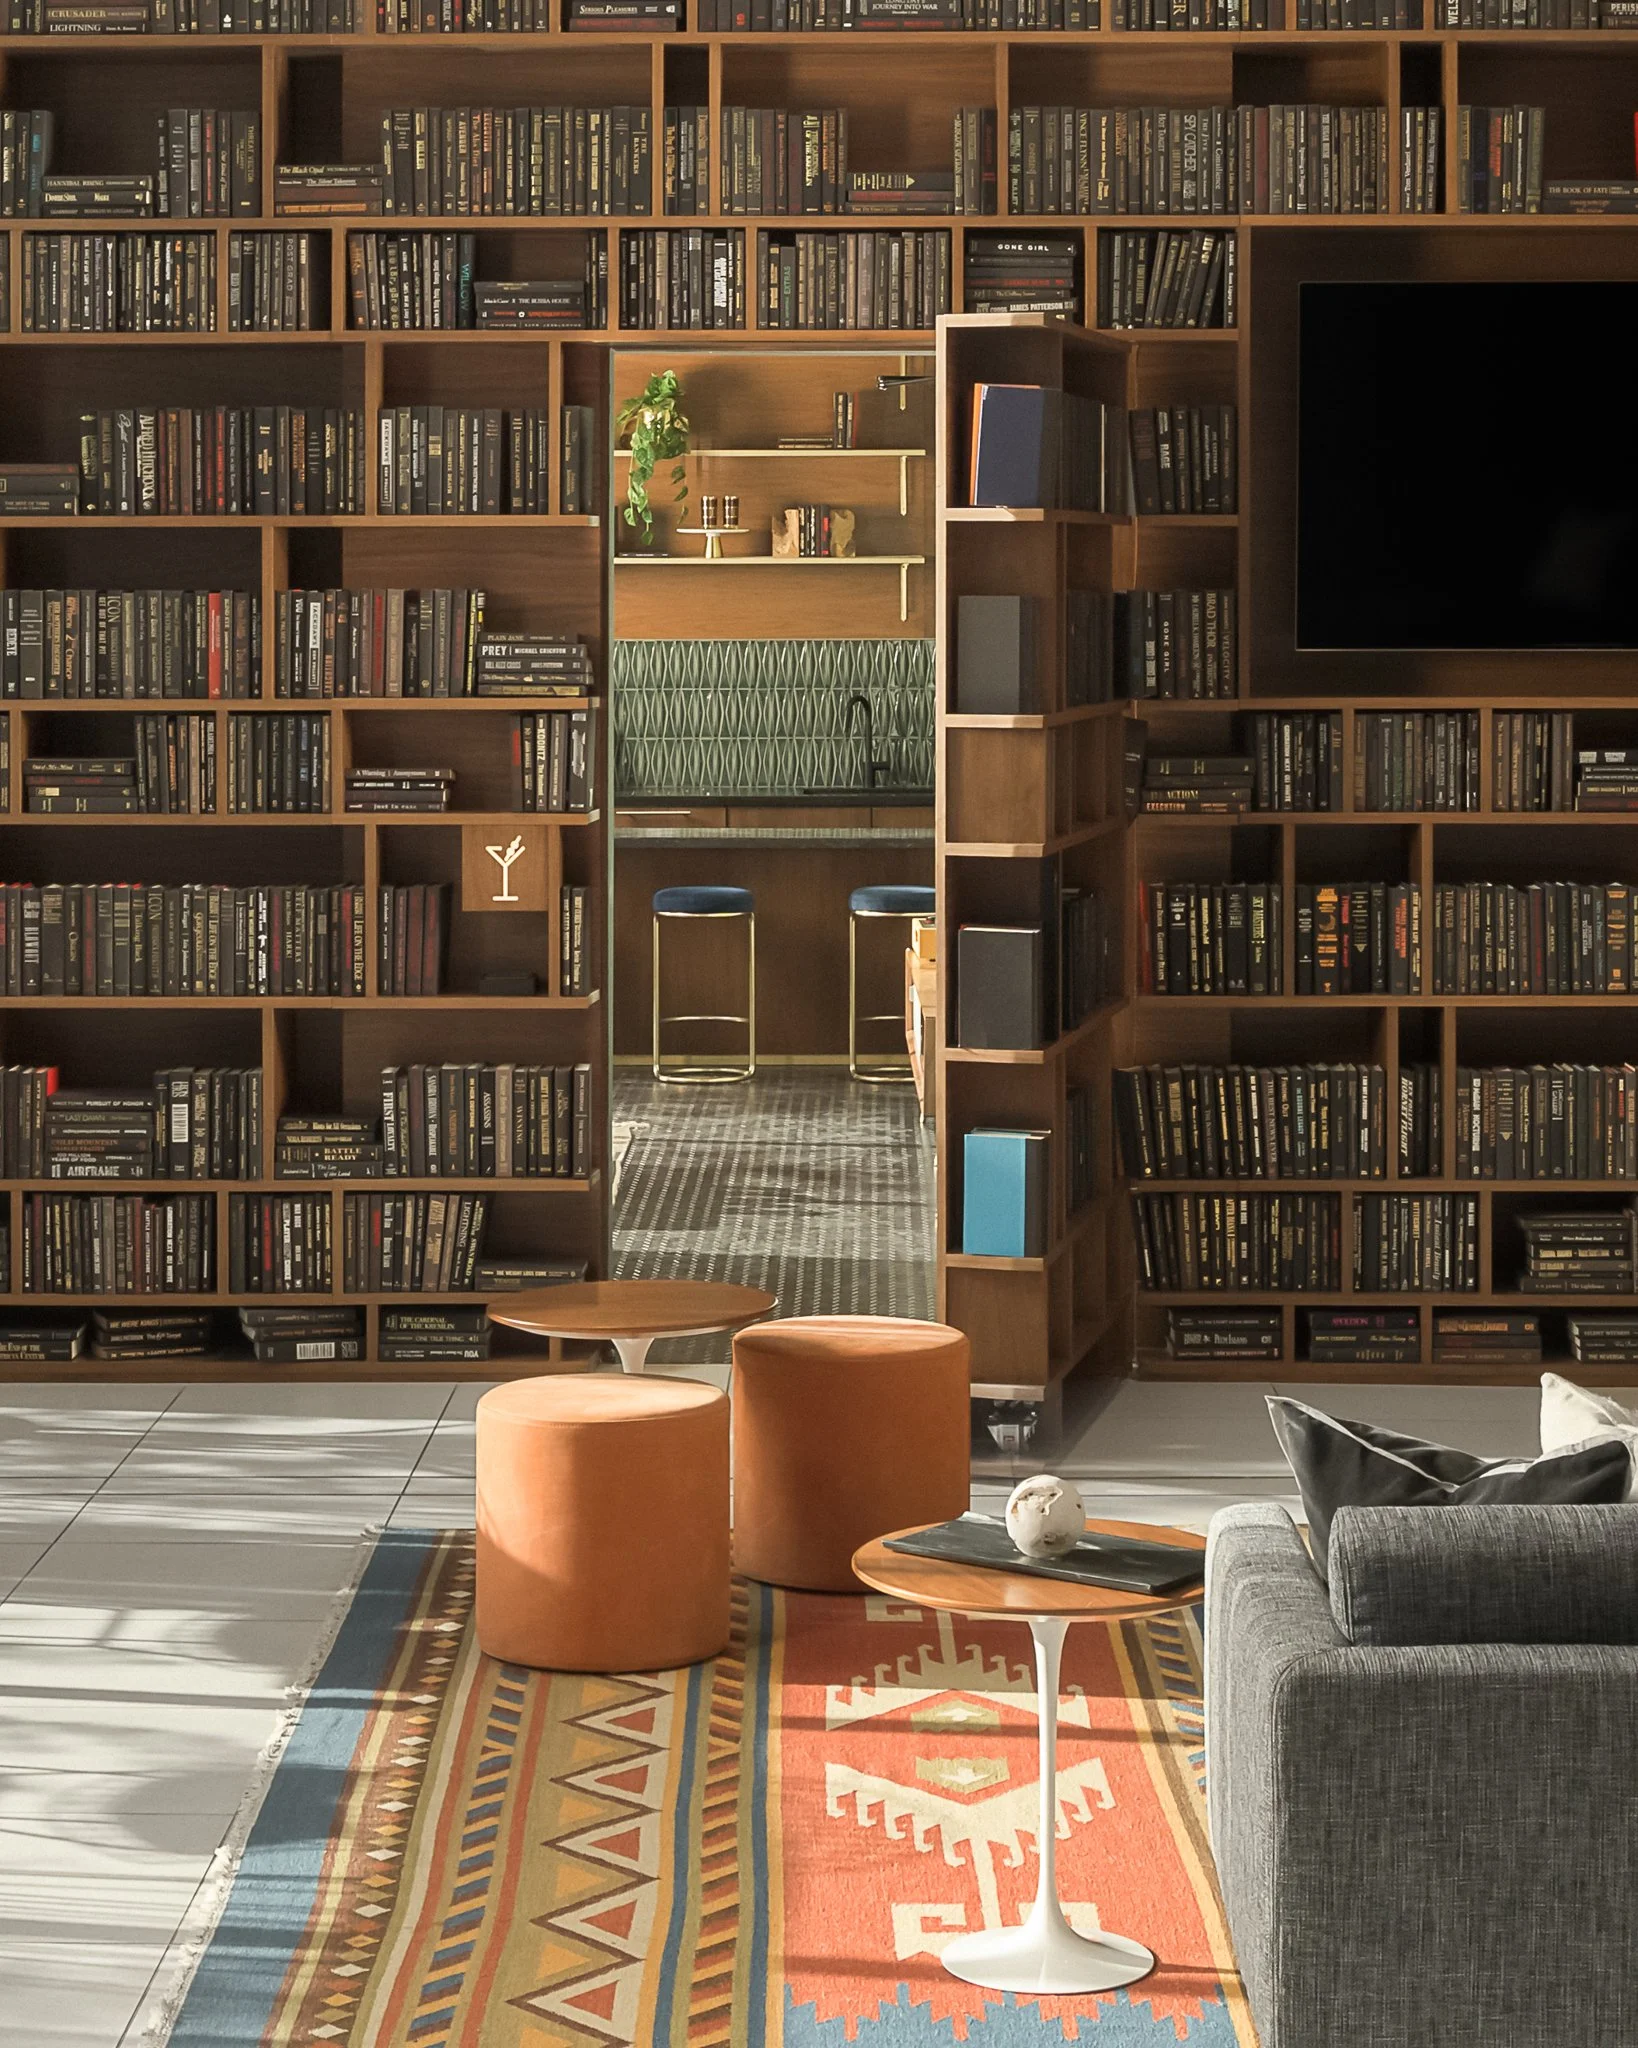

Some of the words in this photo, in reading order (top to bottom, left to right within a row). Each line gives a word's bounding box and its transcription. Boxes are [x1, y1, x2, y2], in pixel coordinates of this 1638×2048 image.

[872, 2, 901, 10] JOURNEY
[903, 2, 920, 10] INTO
[922, 2, 938, 10] WAR
[50, 24, 102, 33] LIGHTNING
[1079, 112, 1088, 140] VINCE
[1184, 114, 1196, 133] SPY
[459, 121, 467, 154] AVENGER
[1079, 141, 1088, 168] FLYNN
[1184, 134, 1196, 172] CATCHER
[998, 244, 1023, 252] GONE
[1028, 244, 1049, 252] GIRL
[461, 263, 470, 311] WILLOW
[139, 415, 155, 451] ALFRED
[1160, 443, 1170, 469] RAGE
[107, 595, 121, 623] ICON
[1206, 593, 1216, 619] BRAD
[1206, 621, 1216, 648] THOR
[482, 646, 507, 656] PREY
[1222, 634, 1230, 680] VELOCITY
[148, 892, 162, 920] ICON
[383, 1092, 395, 1121] FIRST
[516, 1105, 524, 1144] WINNING
[67, 1165, 120, 1176] AIRFRAME
[189, 1201, 197, 1224] POST
[458, 1201, 472, 1247] LIGHTNING
[189, 1227, 197, 1253] GRAD
